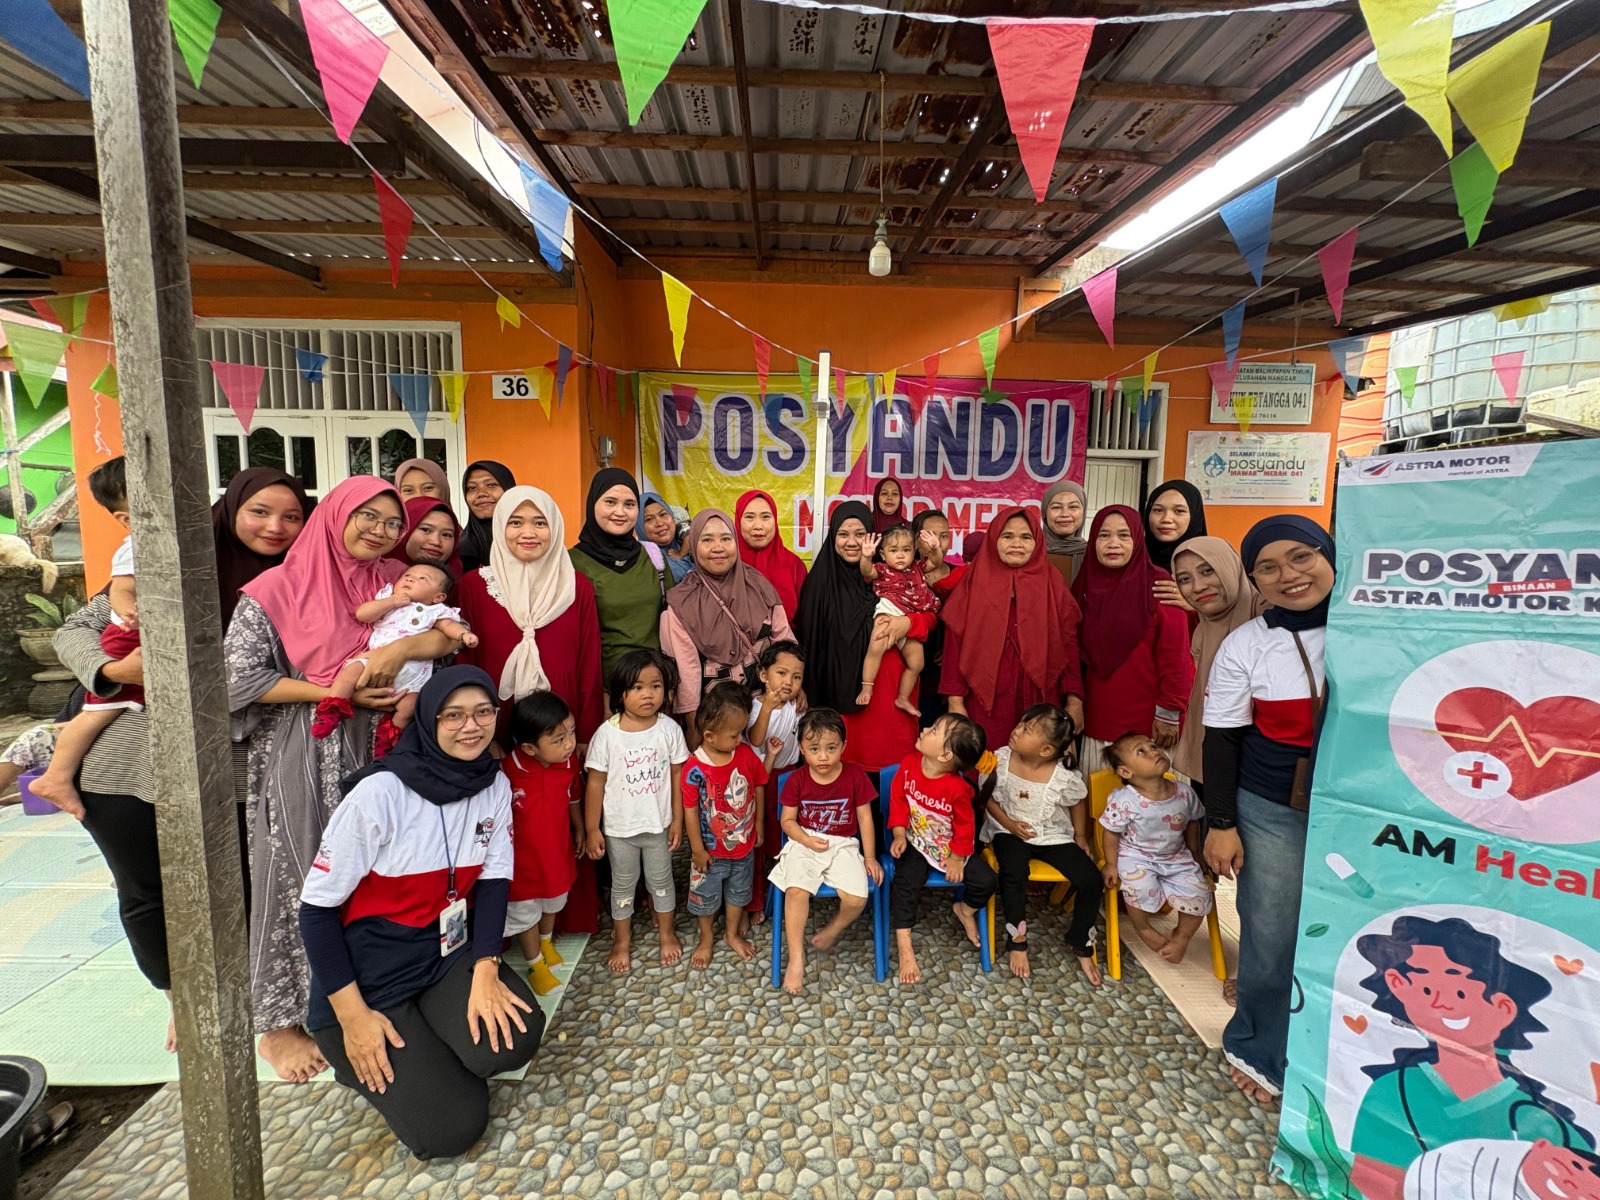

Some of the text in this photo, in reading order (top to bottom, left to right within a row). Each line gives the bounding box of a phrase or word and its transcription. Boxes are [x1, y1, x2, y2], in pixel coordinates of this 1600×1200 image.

[502, 377, 529, 397] 36
[1292, 392, 1307, 409] 041
[660, 391, 1076, 482] POSYANDU
[1228, 456, 1306, 473] posyandu
[1395, 456, 1511, 471] ASTRA MOTOR
[1502, 582, 1556, 592] BINAAN
[1352, 589, 1443, 606] ASTRA
[1453, 592, 1570, 612] MOTOR
[623, 748, 658, 769] best
[625, 766, 661, 784] little
[1371, 823, 1456, 865] AM
